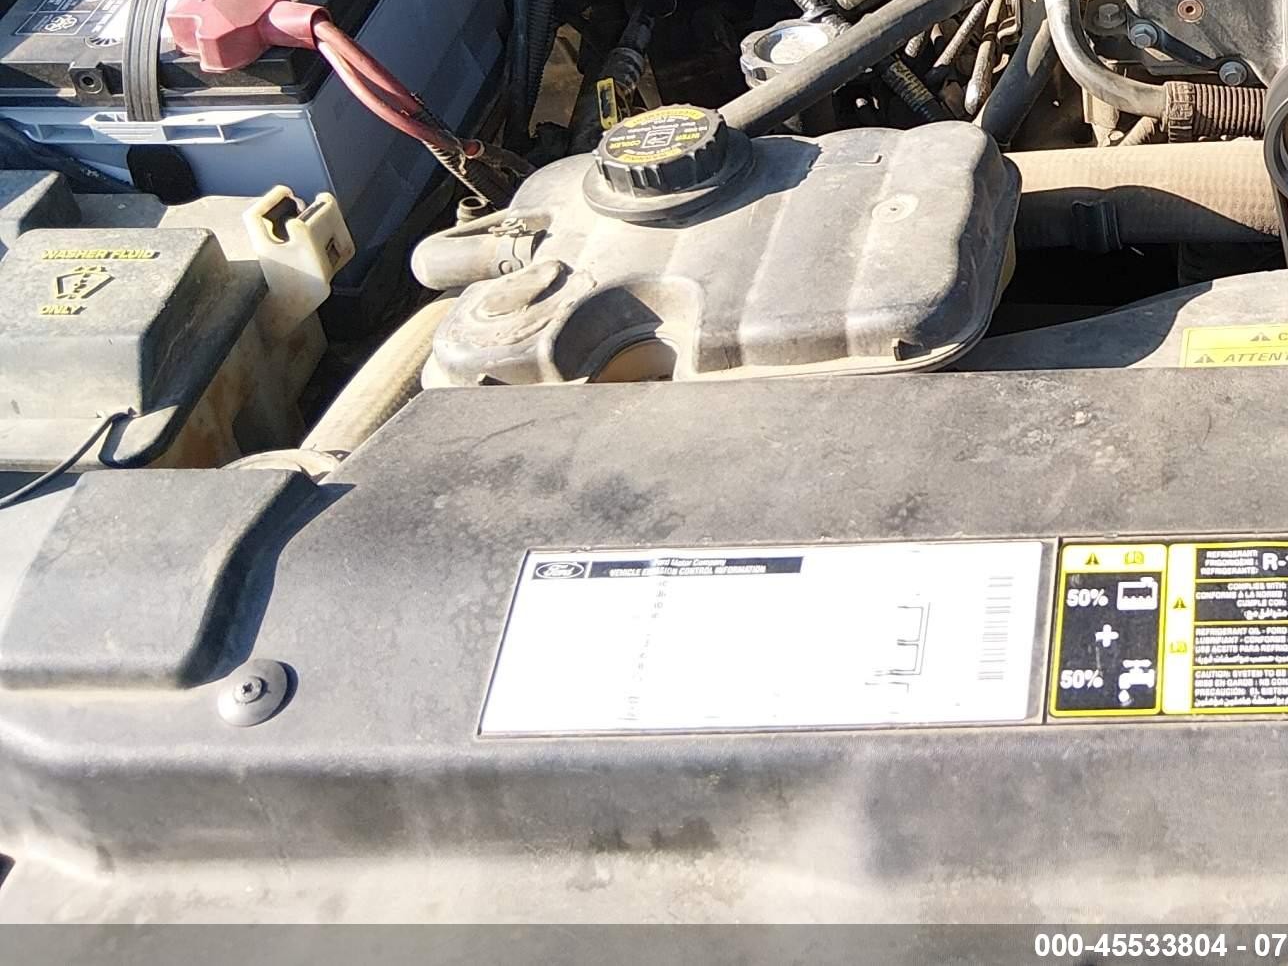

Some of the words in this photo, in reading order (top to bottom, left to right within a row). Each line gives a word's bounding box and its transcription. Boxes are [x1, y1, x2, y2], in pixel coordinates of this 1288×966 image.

[41, 250, 107, 259] WASHER
[110, 250, 155, 259] FLUID
[40, 305, 79, 314] ONLY
[544, 564, 575, 576] Ford
[1067, 589, 1109, 607] 50%
[1095, 624, 1119, 647] +
[1060, 670, 1103, 689] 50%
